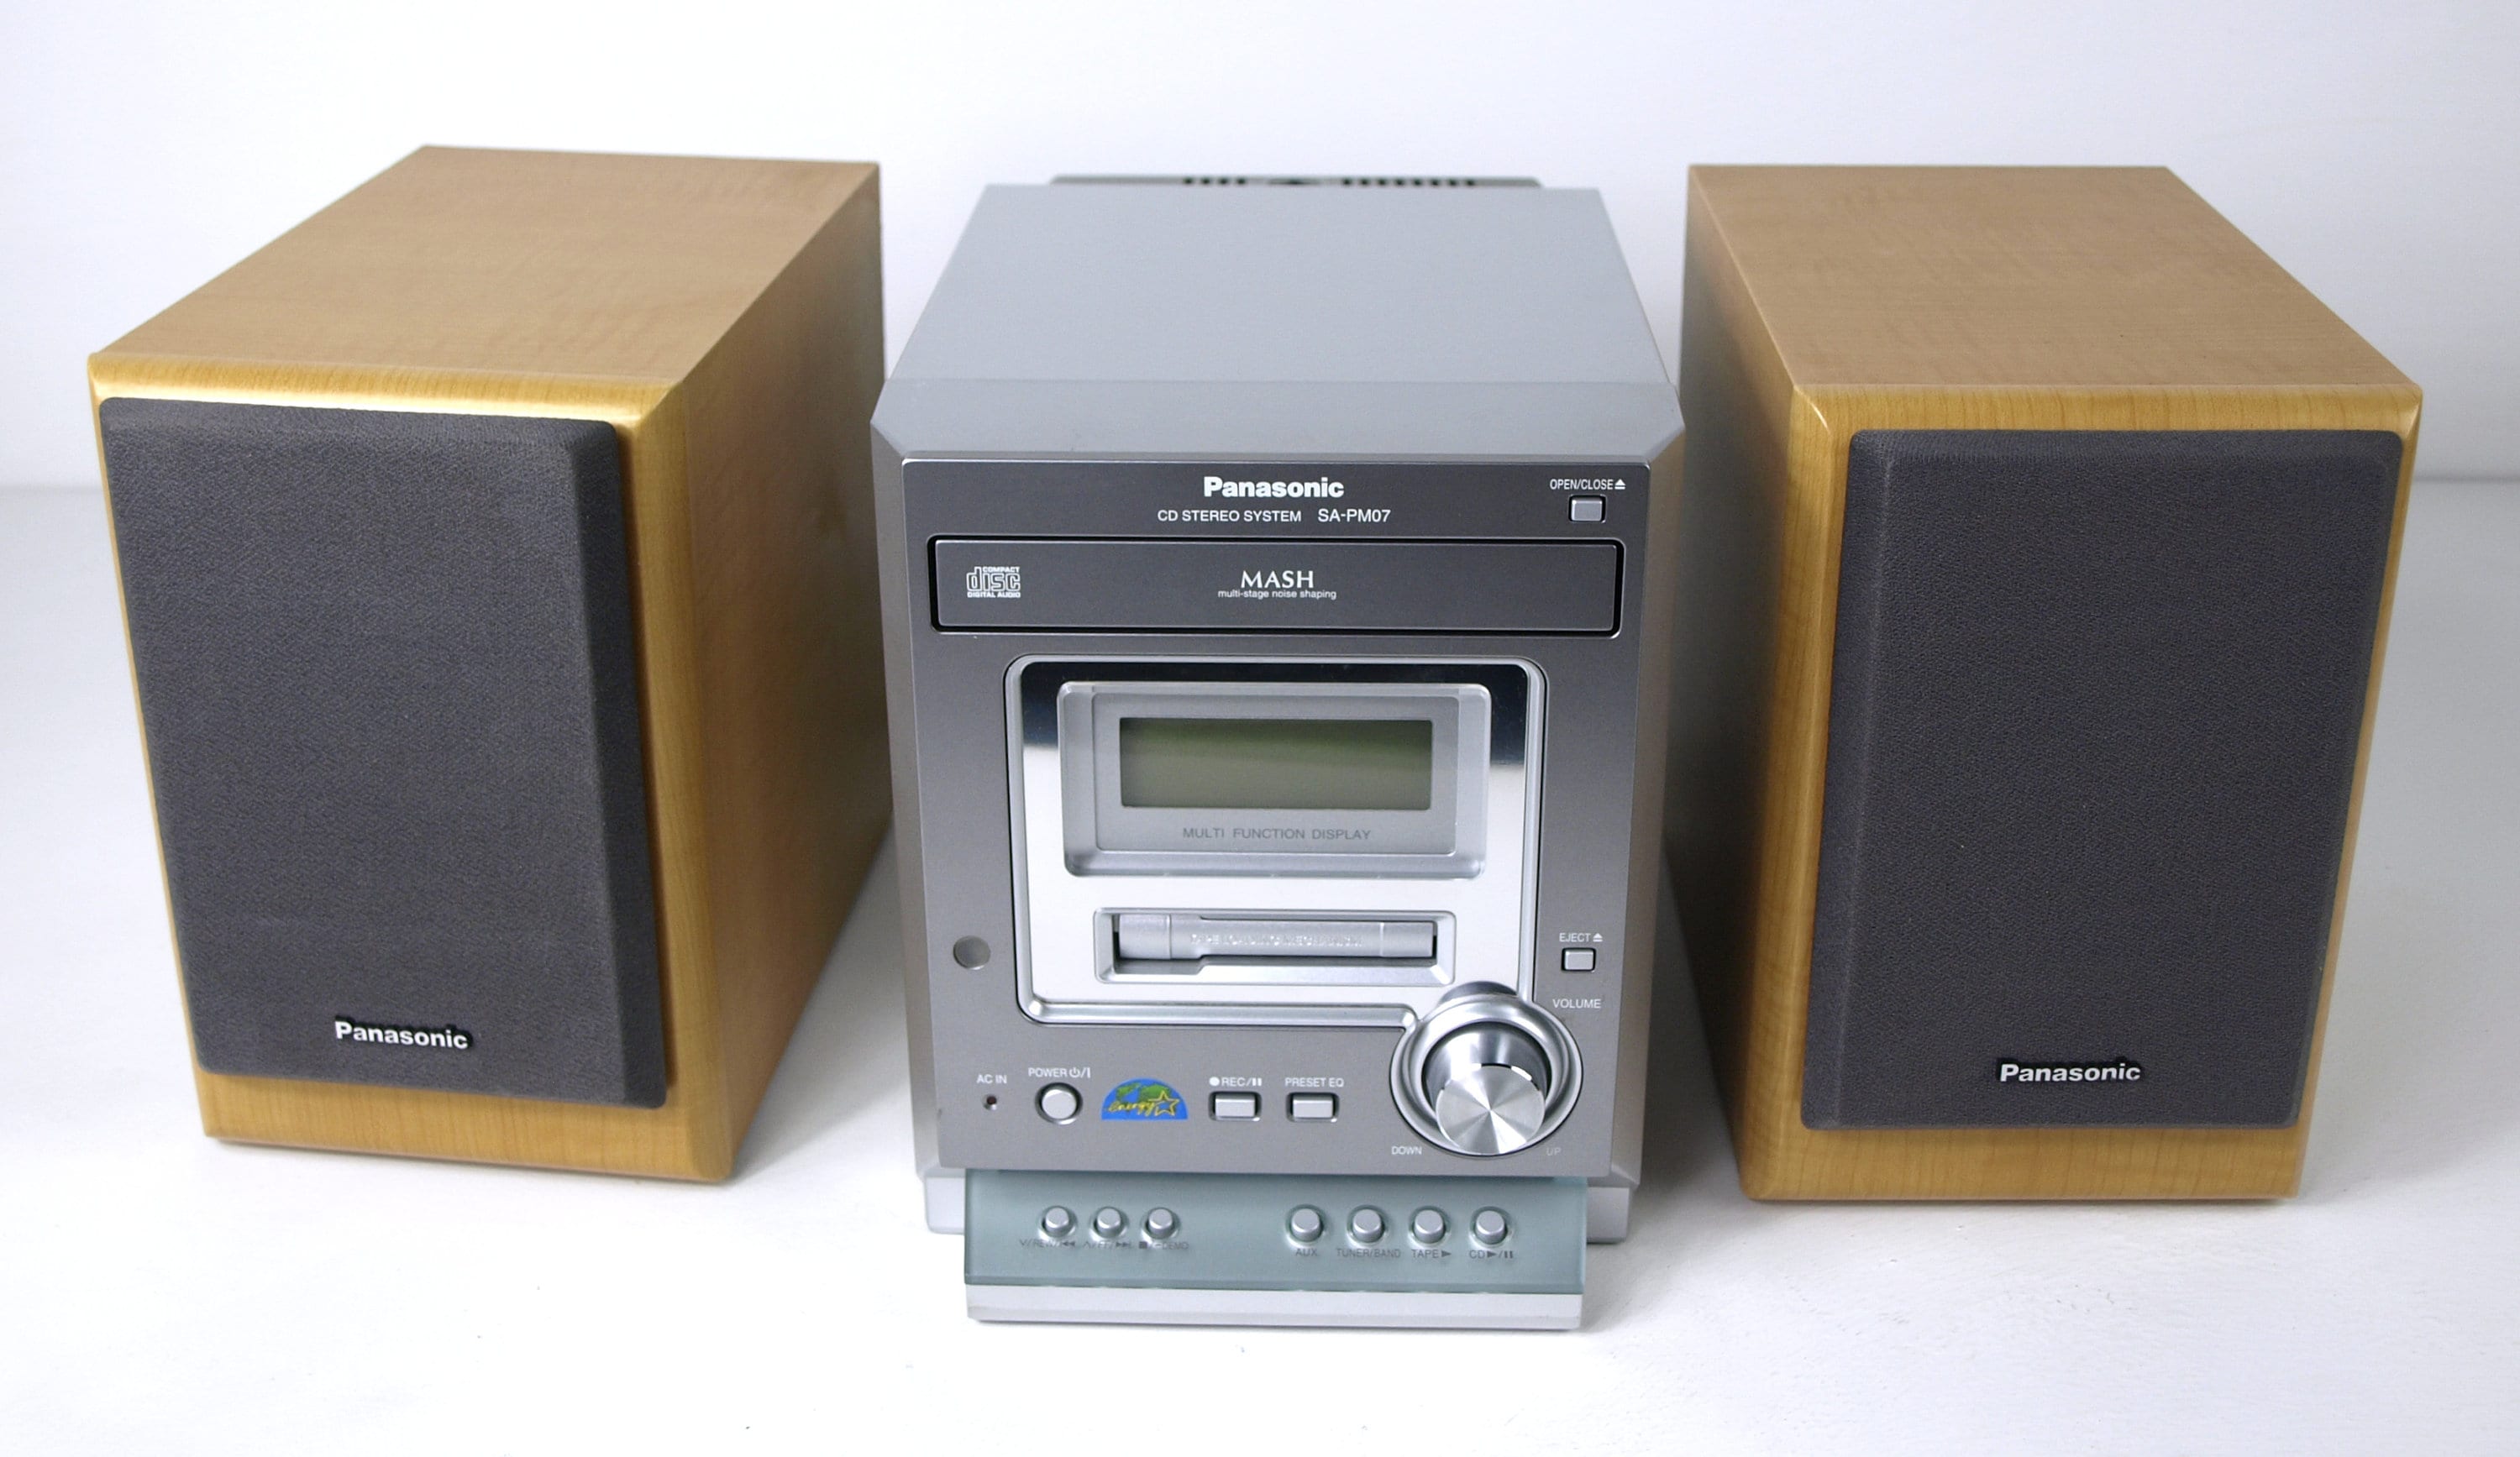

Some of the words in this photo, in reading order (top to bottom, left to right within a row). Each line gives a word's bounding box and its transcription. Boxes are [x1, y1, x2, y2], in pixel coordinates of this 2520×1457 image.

[1204, 476, 1344, 497] Panasonic
[1550, 479, 1614, 490] OPEN/CLOSE
[1158, 510, 1178, 521] CD
[1182, 510, 1240, 521] STEREO
[1243, 511, 1301, 521] SYSTEM
[1317, 509, 1391, 522] SA-PM07
[1241, 570, 1314, 588] MASH
[1218, 590, 1269, 600] multi-stage
[1299, 590, 1336, 600] shaping
[1183, 827, 1225, 838] MULTI
[1233, 828, 1305, 840] FUNCTION
[1312, 829, 1371, 841] DISPLAY
[1559, 933, 1590, 942] EJECT
[1552, 998, 1601, 1009] VOLUME
[335, 1020, 469, 1049] Panasonic
[1028, 1067, 1067, 1077] POWER
[2000, 1063, 2141, 1082] Panasonic
[977, 1074, 993, 1084] AC
[995, 1075, 1007, 1084] IN
[1285, 1077, 1326, 1088] PRESET
[1329, 1078, 1344, 1088] EQ
[1391, 1145, 1422, 1156] DOWN
[1546, 1147, 1562, 1156] UP
[1295, 1248, 1317, 1257] AUX
[1336, 1249, 1401, 1258] TUNER/BAND
[1412, 1250, 1439, 1258] TAPE
[1470, 1250, 1486, 1259] CD
